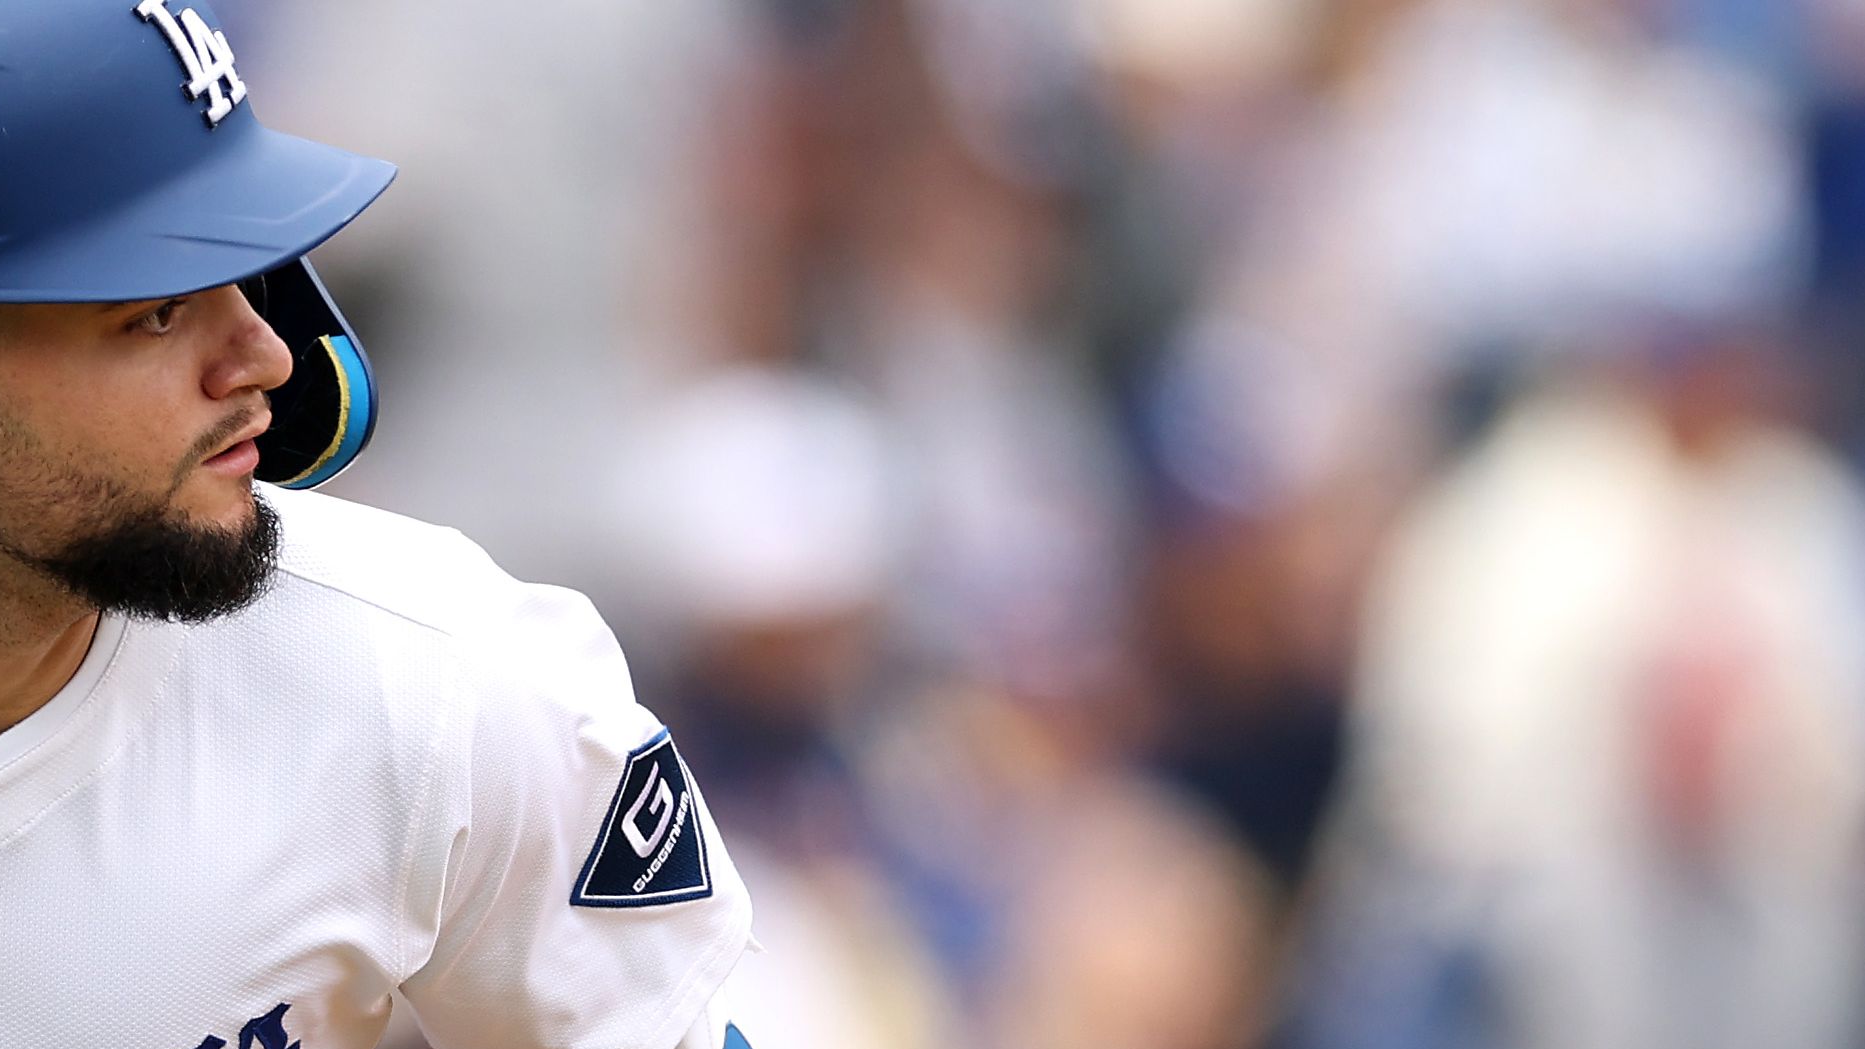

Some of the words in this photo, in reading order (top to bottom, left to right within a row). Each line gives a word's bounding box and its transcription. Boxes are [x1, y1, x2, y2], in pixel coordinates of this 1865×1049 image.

[133, 0, 247, 124] LA
[621, 761, 674, 858] G
[633, 791, 690, 892] GUGGENHEIM
